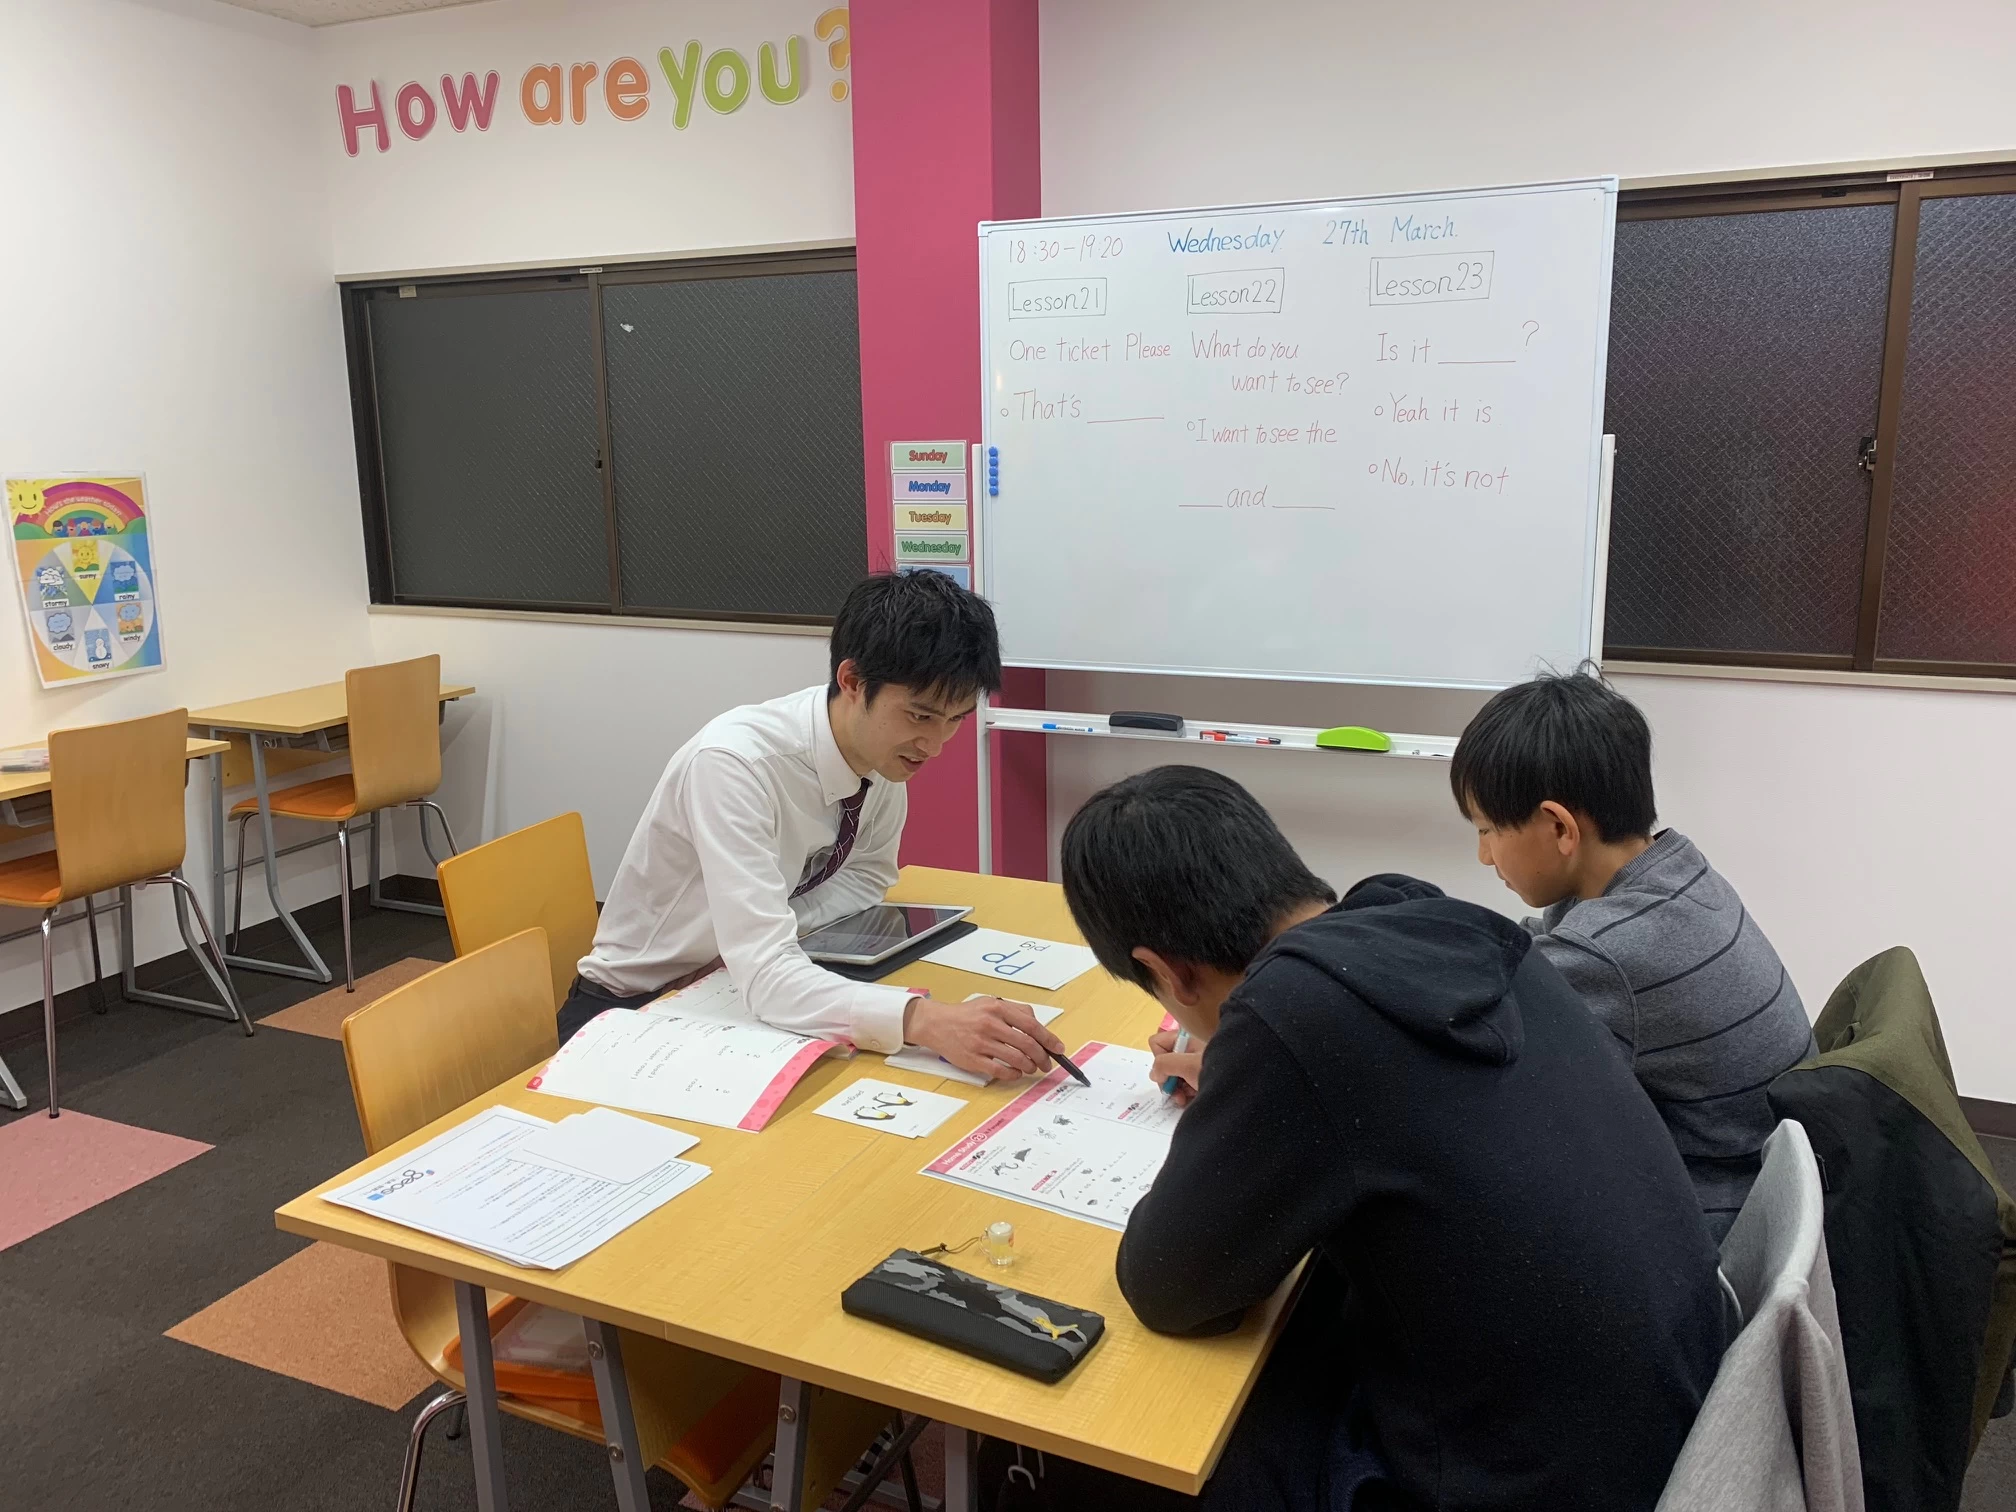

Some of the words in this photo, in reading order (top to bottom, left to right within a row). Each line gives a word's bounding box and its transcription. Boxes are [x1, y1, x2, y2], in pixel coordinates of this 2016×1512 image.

[335, 69, 501, 158] How
[519, 56, 651, 126] are
[1322, 218, 1369, 246] 27th
[1009, 339, 1047, 361] One
[1125, 332, 1172, 362] Please
[1191, 329, 1242, 360] What
[1247, 336, 1266, 358] do
[1375, 332, 1399, 363] Is
[1411, 337, 1432, 364] it
[1521, 319, 1541, 353] ?
[1231, 369, 1279, 393] want
[1286, 372, 1301, 393] to
[1303, 371, 1351, 396] see?
[1013, 387, 1082, 422] That's
[1389, 391, 1430, 424] Yeah
[1442, 397, 1460, 423] it
[1195, 417, 1209, 443] I
[1212, 424, 1249, 445] want
[1255, 423, 1267, 445] to
[1269, 427, 1300, 445] see
[1305, 418, 1338, 445] the
[908, 448, 948, 464] Sunday
[1381, 456, 1415, 488] No,
[1422, 460, 1456, 488] it's
[1464, 465, 1511, 495] not
[908, 479, 952, 496] Monday
[1226, 484, 1268, 509] and
[76, 495, 102, 504] weather
[908, 510, 952, 526] Tuesday
[901, 540, 962, 556] Wednesday
[44, 599, 68, 608] stormy
[118, 592, 136, 601] rainy
[53, 642, 74, 652] cloudy
[123, 634, 142, 643] windy
[92, 661, 110, 670] snowy
[1019, 940, 1052, 952] pig
